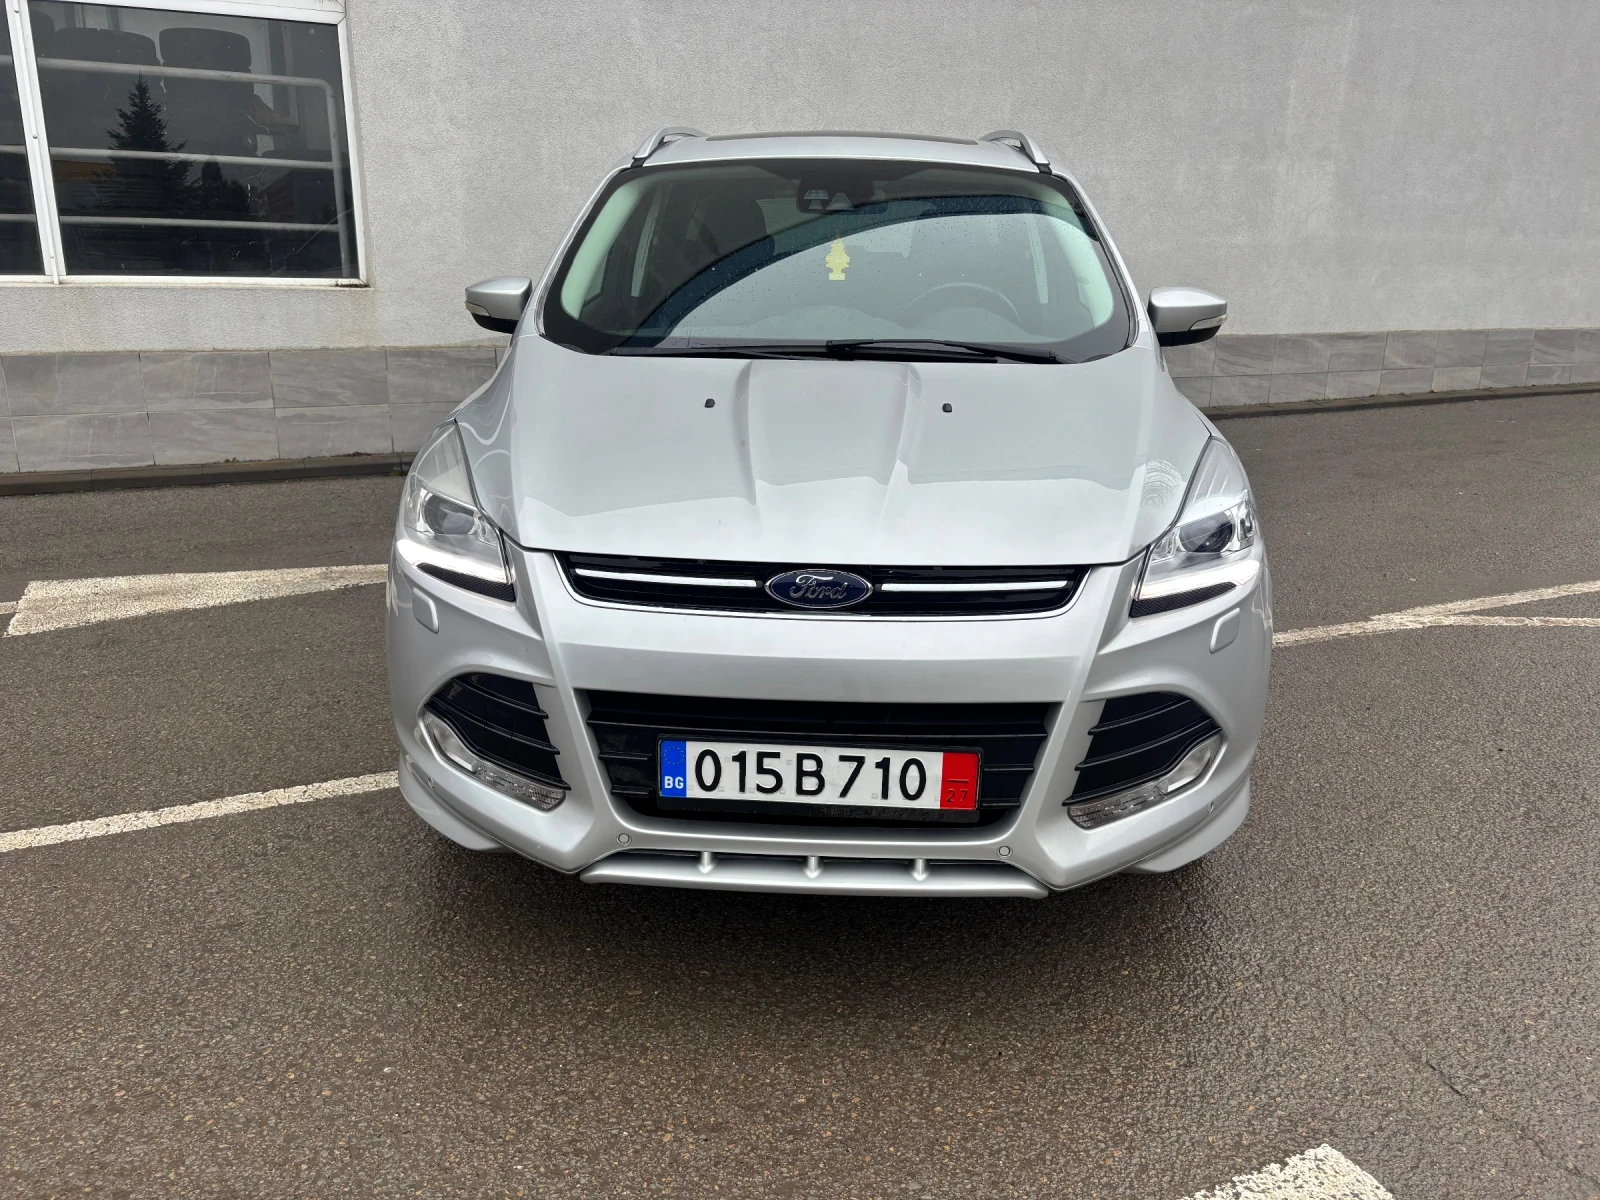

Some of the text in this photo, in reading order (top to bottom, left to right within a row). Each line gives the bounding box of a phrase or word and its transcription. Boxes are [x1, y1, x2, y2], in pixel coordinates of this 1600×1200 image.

[789, 574, 848, 600] Ford
[664, 775, 684, 789] BG
[946, 788, 969, 803] 27
